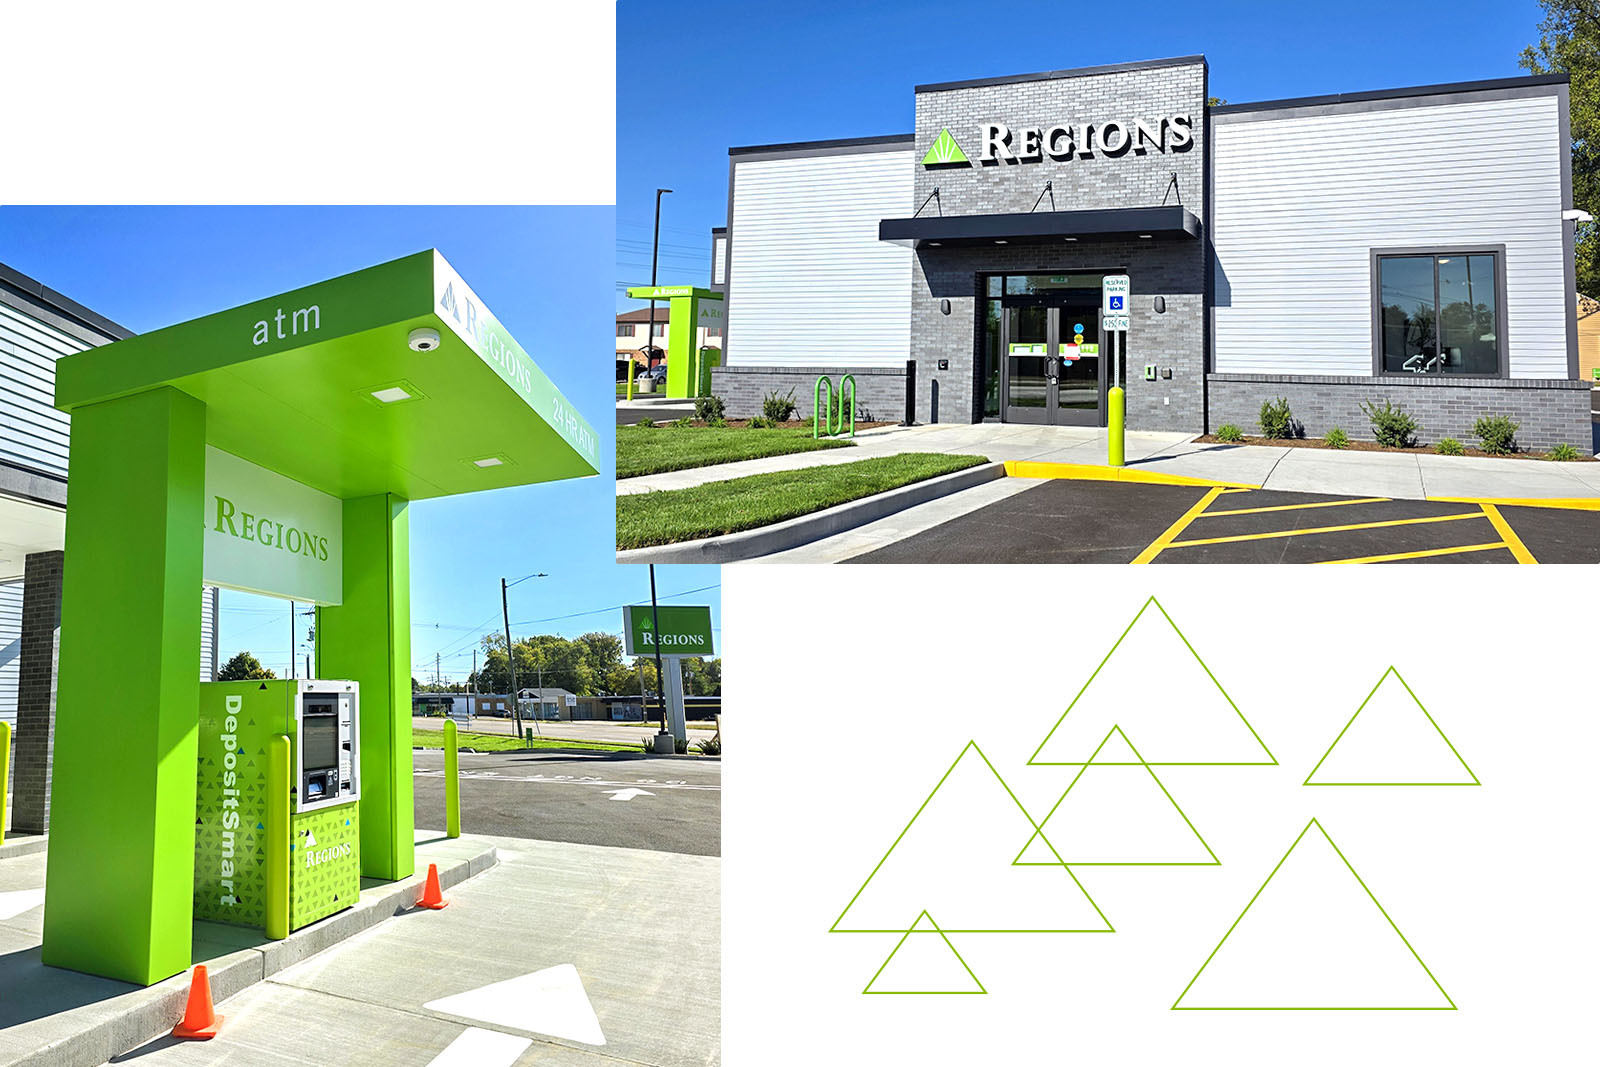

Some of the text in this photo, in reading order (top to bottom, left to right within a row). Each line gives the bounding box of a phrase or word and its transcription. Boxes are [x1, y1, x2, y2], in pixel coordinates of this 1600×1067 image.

[977, 113, 1193, 162] REGIONS
[660, 288, 689, 296] REGIONS
[252, 304, 320, 346] atm
[463, 296, 532, 394] REGIONS
[552, 397, 595, 459] 24 HR ATM
[213, 494, 329, 562] REGIONS
[642, 631, 705, 646] REGIONS
[220, 695, 242, 907] DepositSmart
[306, 841, 351, 869] REGIONS
